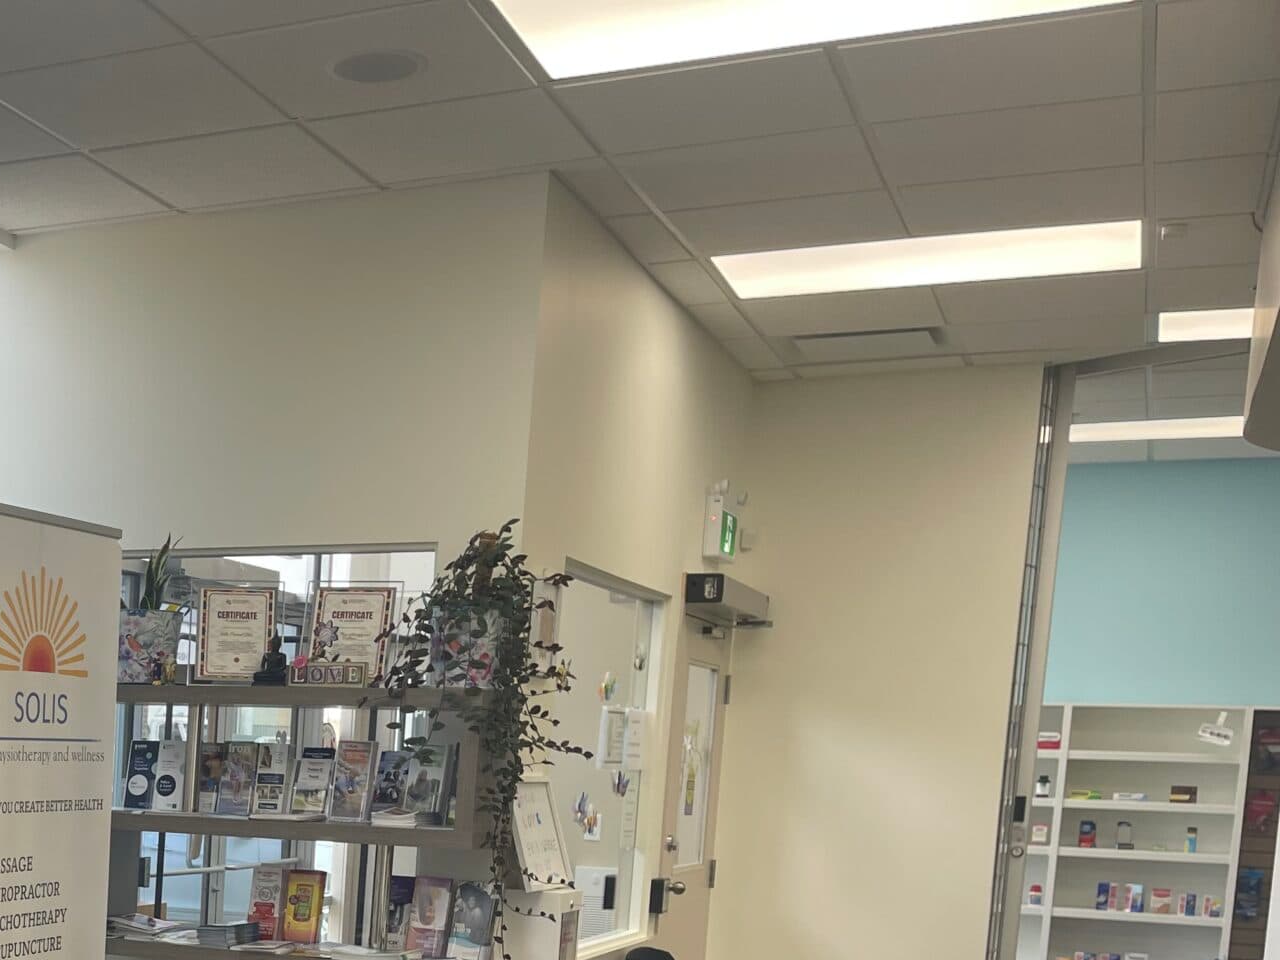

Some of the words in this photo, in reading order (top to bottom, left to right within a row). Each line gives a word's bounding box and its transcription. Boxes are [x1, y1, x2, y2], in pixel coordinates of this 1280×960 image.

[217, 611, 258, 620] CERTIFICATE
[332, 610, 374, 620] CERTIFICATE
[293, 666, 358, 683] LOVE
[14, 691, 69, 724] SOLIS
[53, 745, 70, 762] and
[71, 745, 105, 762] wellness
[14, 800, 45, 814] CREATE
[45, 799, 73, 813] BETTER
[74, 798, 104, 812] HEALTH
